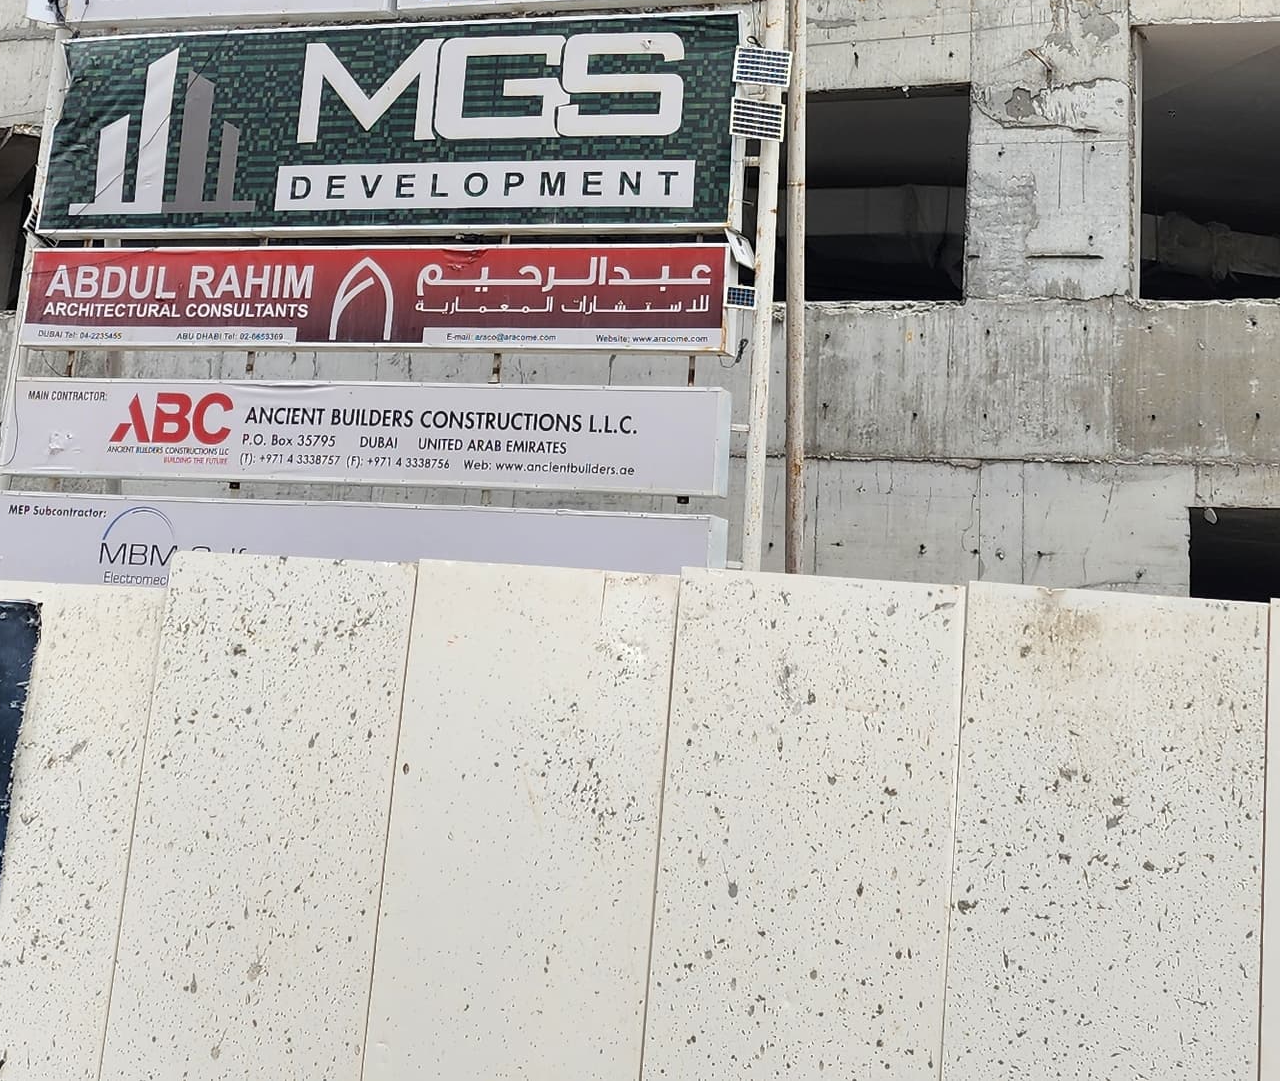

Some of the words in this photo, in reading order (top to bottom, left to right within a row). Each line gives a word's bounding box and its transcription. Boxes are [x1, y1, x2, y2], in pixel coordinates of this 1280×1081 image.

[296, 32, 686, 144] MGS
[289, 170, 679, 200] DEVELOPMENT
[45, 265, 176, 299] ABDUL
[187, 265, 314, 299] RAHIM
[43, 302, 180, 319] ARCHITECTURAL
[185, 302, 309, 319] CONSULTANTS
[38, 329, 62, 338] DUBAI
[176, 332, 194, 340] ABU
[196, 332, 222, 340] DHABI
[632, 335, 709, 343] www.aracome.com
[28, 390, 49, 401] MAIN
[51, 391, 108, 401] CONTRACTOR:
[109, 392, 234, 445] ABC
[245, 406, 325, 425] ANCIENT
[331, 408, 413, 428] BUILDERS
[420, 410, 582, 433] CONSTRUCTIONS
[588, 415, 637, 434] L.L.C.
[107, 446, 134, 454] ANCIENT
[135, 446, 164, 454] BUILDERS
[164, 447, 218, 455] CONSTRUCTIONS
[219, 447, 229, 455] LLC
[242, 434, 266, 446] P.O.
[271, 435, 292, 446] Box
[297, 435, 336, 447] 35795
[360, 436, 398, 449] DUBAI
[418, 437, 463, 451] UNITED
[467, 439, 501, 452] ARAB
[506, 440, 567, 455] EMIRATES
[163, 456, 192, 464] BUILDING
[205, 457, 228, 465] FUTURE
[240, 452, 256, 466] (T):
[259, 454, 283, 464] +971
[287, 454, 293, 464] 4
[296, 454, 340, 465] 3338757
[346, 455, 363, 469] (F):
[367, 456, 391, 467] +971
[395, 456, 402, 467] 4
[405, 456, 450, 470] 3338756
[464, 459, 491, 470] Web:
[495, 461, 635, 476] www.ancientbuilders.ae
[8, 504, 30, 515] MEP
[33, 505, 108, 519] Subcontractor:
[99, 542, 178, 567] MBM
